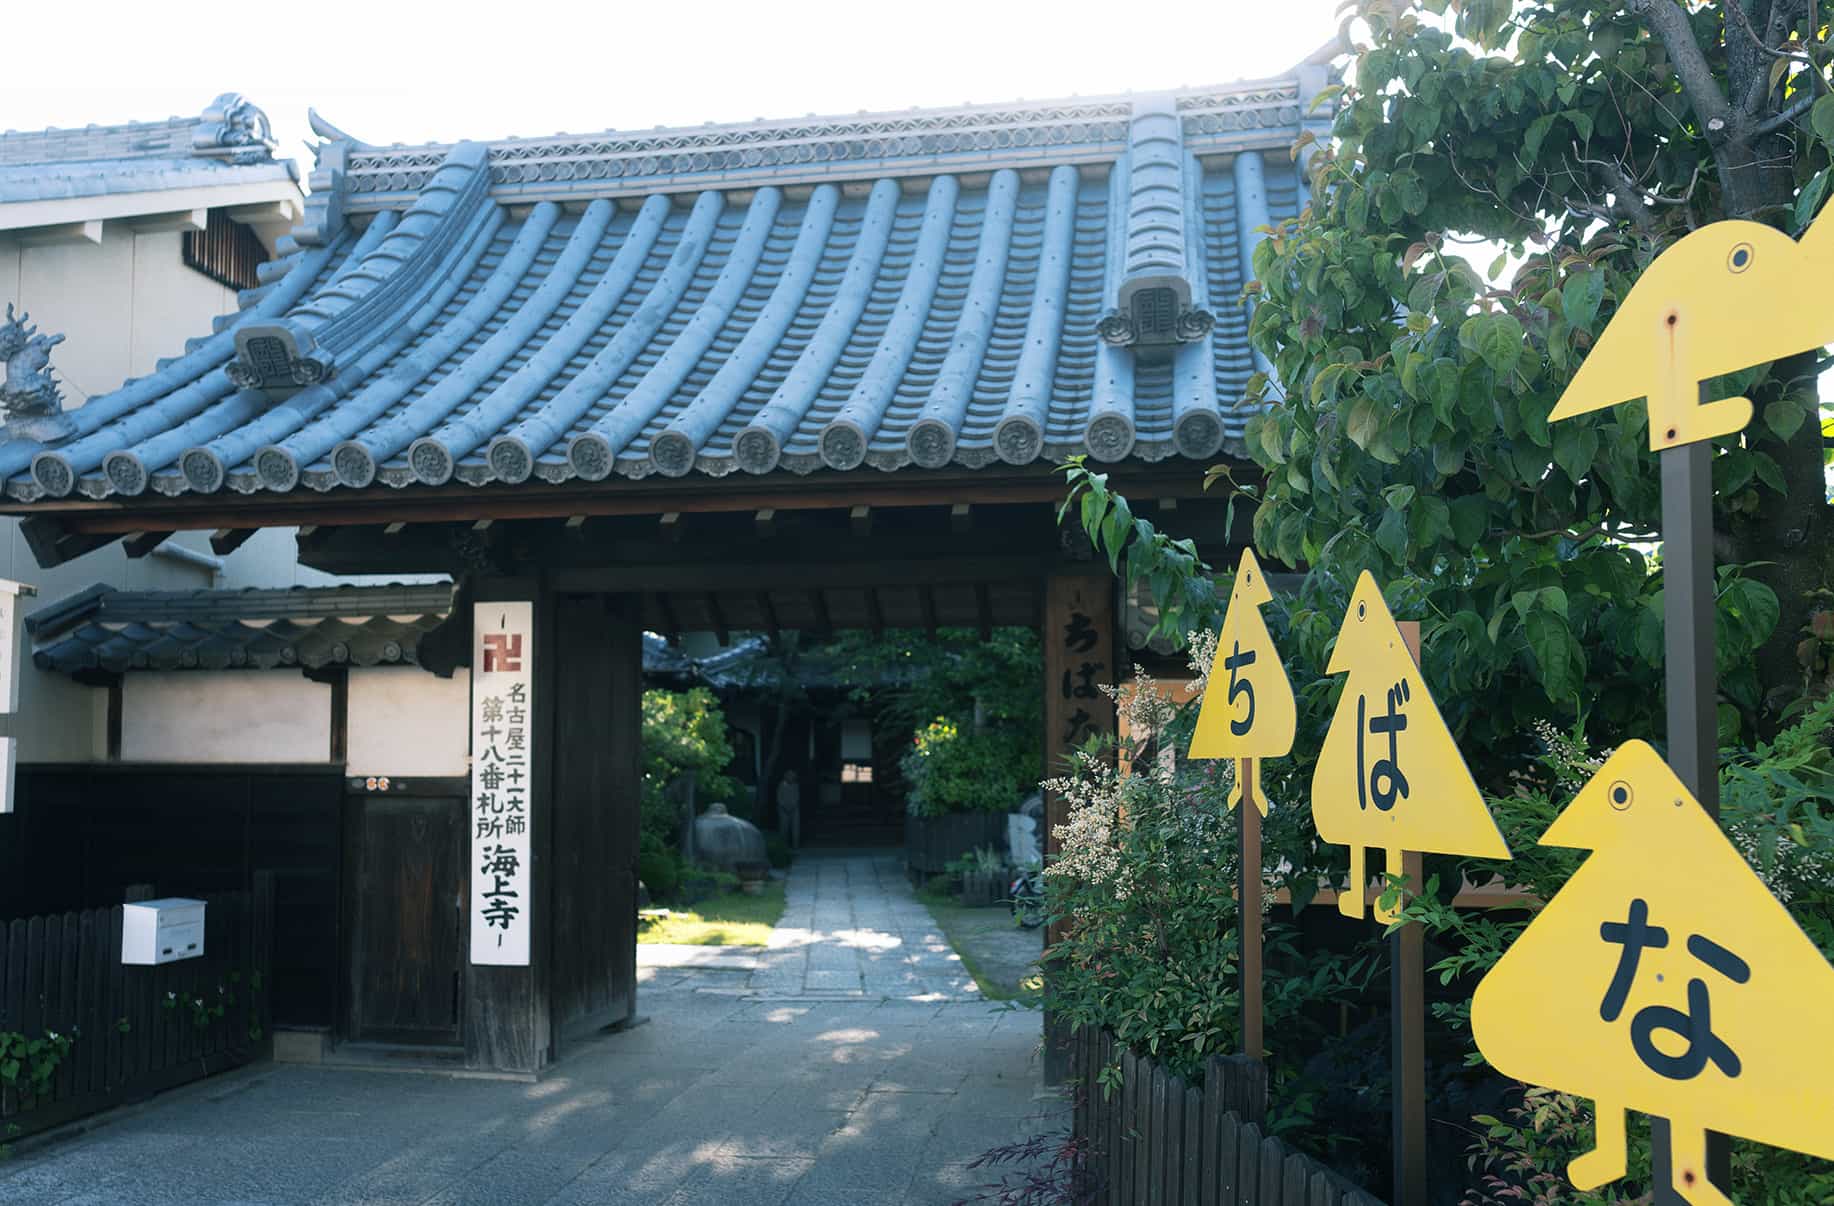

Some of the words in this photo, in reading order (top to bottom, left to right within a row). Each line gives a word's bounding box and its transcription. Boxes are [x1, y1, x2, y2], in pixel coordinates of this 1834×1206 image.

[1224, 639, 1256, 736] ち
[1357, 678, 1410, 811] ば
[476, 696, 505, 840] 第十八番札所
[504, 682, 527, 835] 名古屋二十一大師
[480, 845, 520, 930] 海上寺
[1599, 898, 1751, 1081] な
